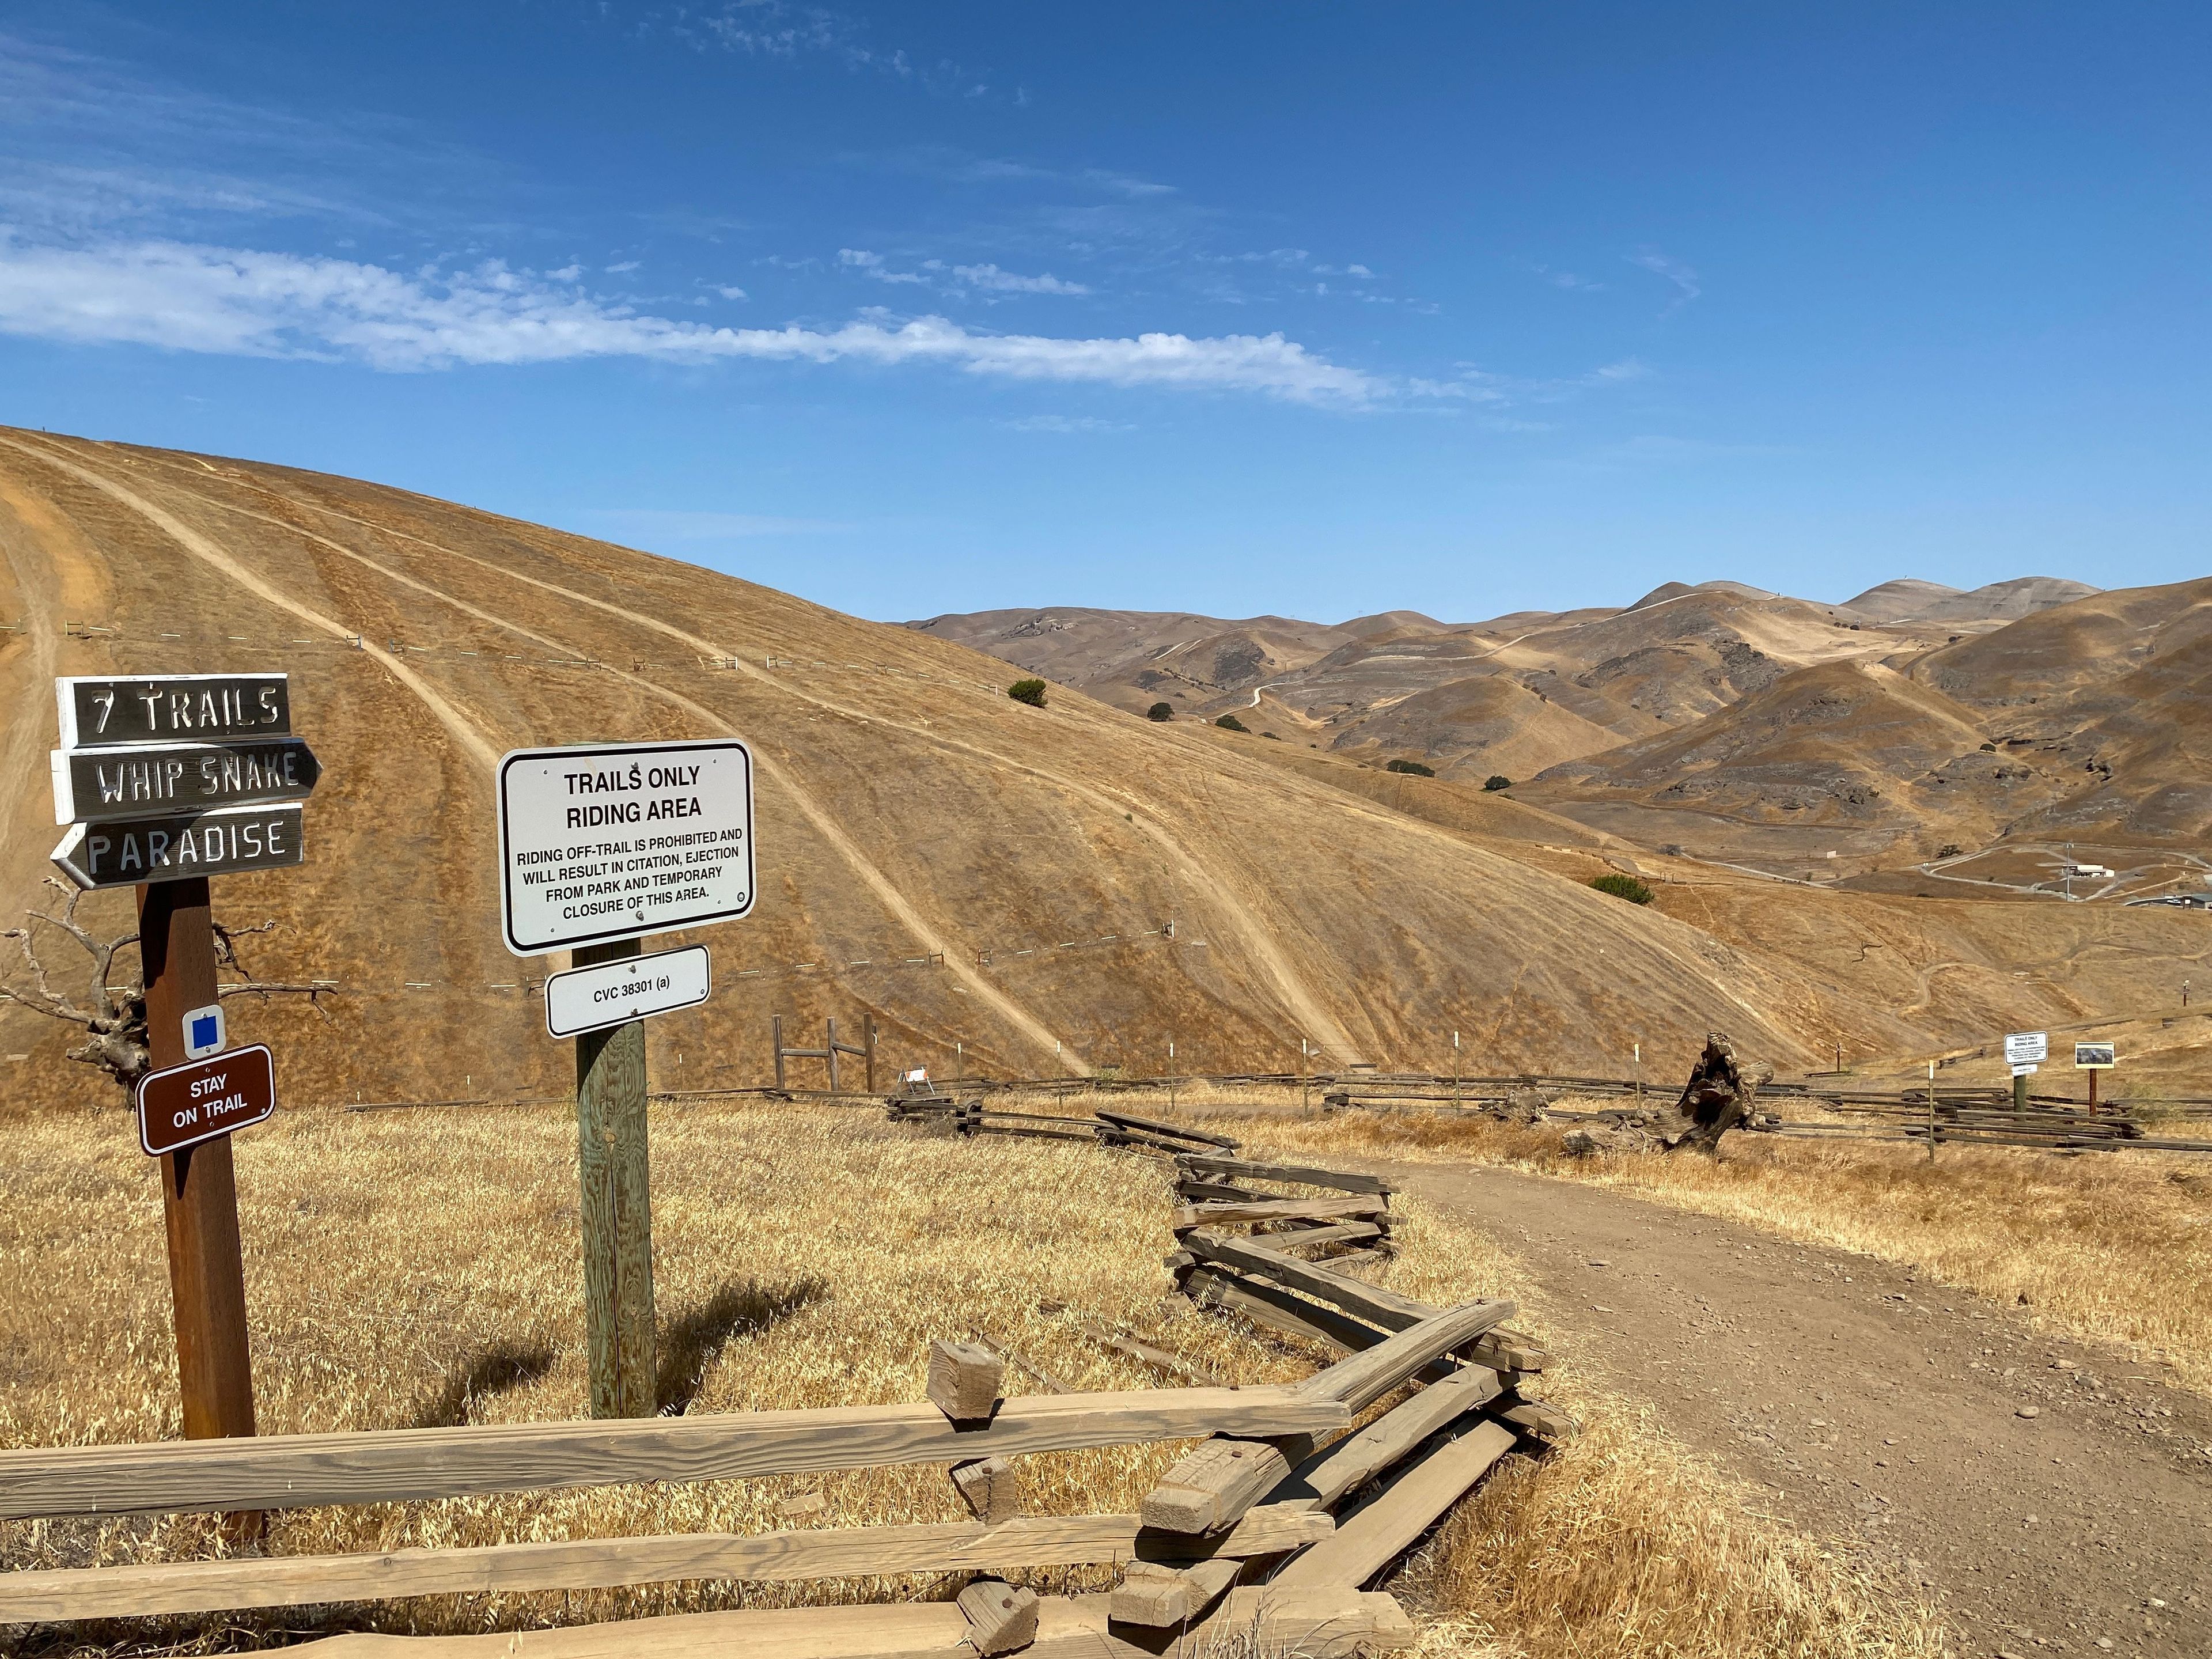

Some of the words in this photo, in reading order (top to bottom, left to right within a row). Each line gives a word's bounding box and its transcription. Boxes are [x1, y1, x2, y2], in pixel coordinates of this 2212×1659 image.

[91, 688, 114, 733] 7
[136, 686, 278, 731] TRAILS
[95, 759, 183, 804] WHIP
[199, 752, 299, 795] SNAKE
[563, 769, 642, 795] TRAILS
[648, 765, 700, 789] ONLY
[566, 801, 641, 829] RIDING
[646, 797, 702, 821] AREA
[88, 820, 286, 874] PARADISE
[517, 849, 563, 866] RIDING
[567, 841, 632, 860] OFF-TRAIL
[635, 839, 646, 852] IS
[649, 831, 718, 850] PROHIBITED
[719, 828, 743, 842] AND
[522, 869, 556, 885] WILL
[559, 862, 608, 881] RESULT
[611, 859, 624, 874] IN
[626, 853, 683, 872] CITATION,
[685, 846, 739, 863] EJECTION
[546, 884, 584, 903] FROM
[588, 880, 622, 897] PARK
[624, 876, 650, 892] AND
[652, 866, 723, 887] TEMPORARY
[563, 899, 624, 920] CLOSURE
[627, 895, 643, 910] OF
[646, 891, 673, 907] THIS
[675, 887, 710, 902] AREA.
[593, 986, 619, 1003] CVC
[622, 979, 653, 997] 38301
[656, 975, 670, 991] (a)
[190, 1073, 228, 1099] STAY
[173, 1107, 198, 1128] ON
[203, 1093, 248, 1118] TRAIL
